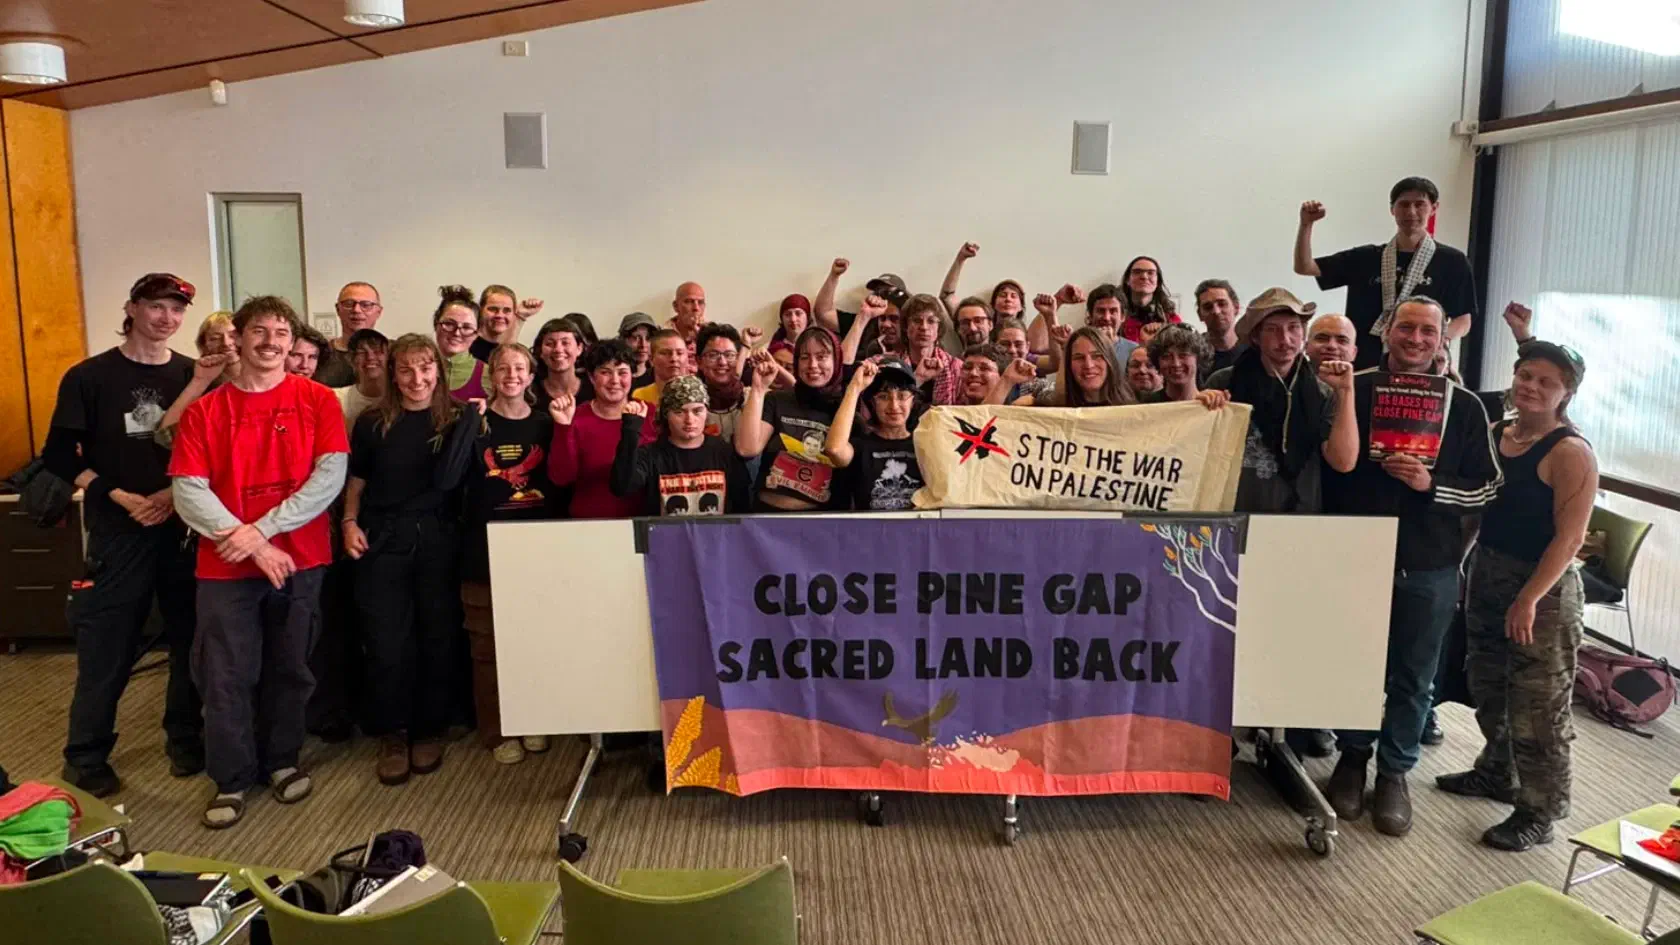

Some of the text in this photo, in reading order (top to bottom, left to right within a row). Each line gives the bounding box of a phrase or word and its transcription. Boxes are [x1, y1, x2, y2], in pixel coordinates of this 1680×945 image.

[1373, 406, 1443, 423] CLOSE PINE GAP
[1392, 395, 1421, 408] BASES
[1017, 433, 1183, 484] STOP THE WAR
[1010, 462, 1173, 511] ON PALESTINE
[753, 572, 1142, 616] CLOSE PINE GAP
[716, 637, 1181, 683] SACRED LAND BACK
